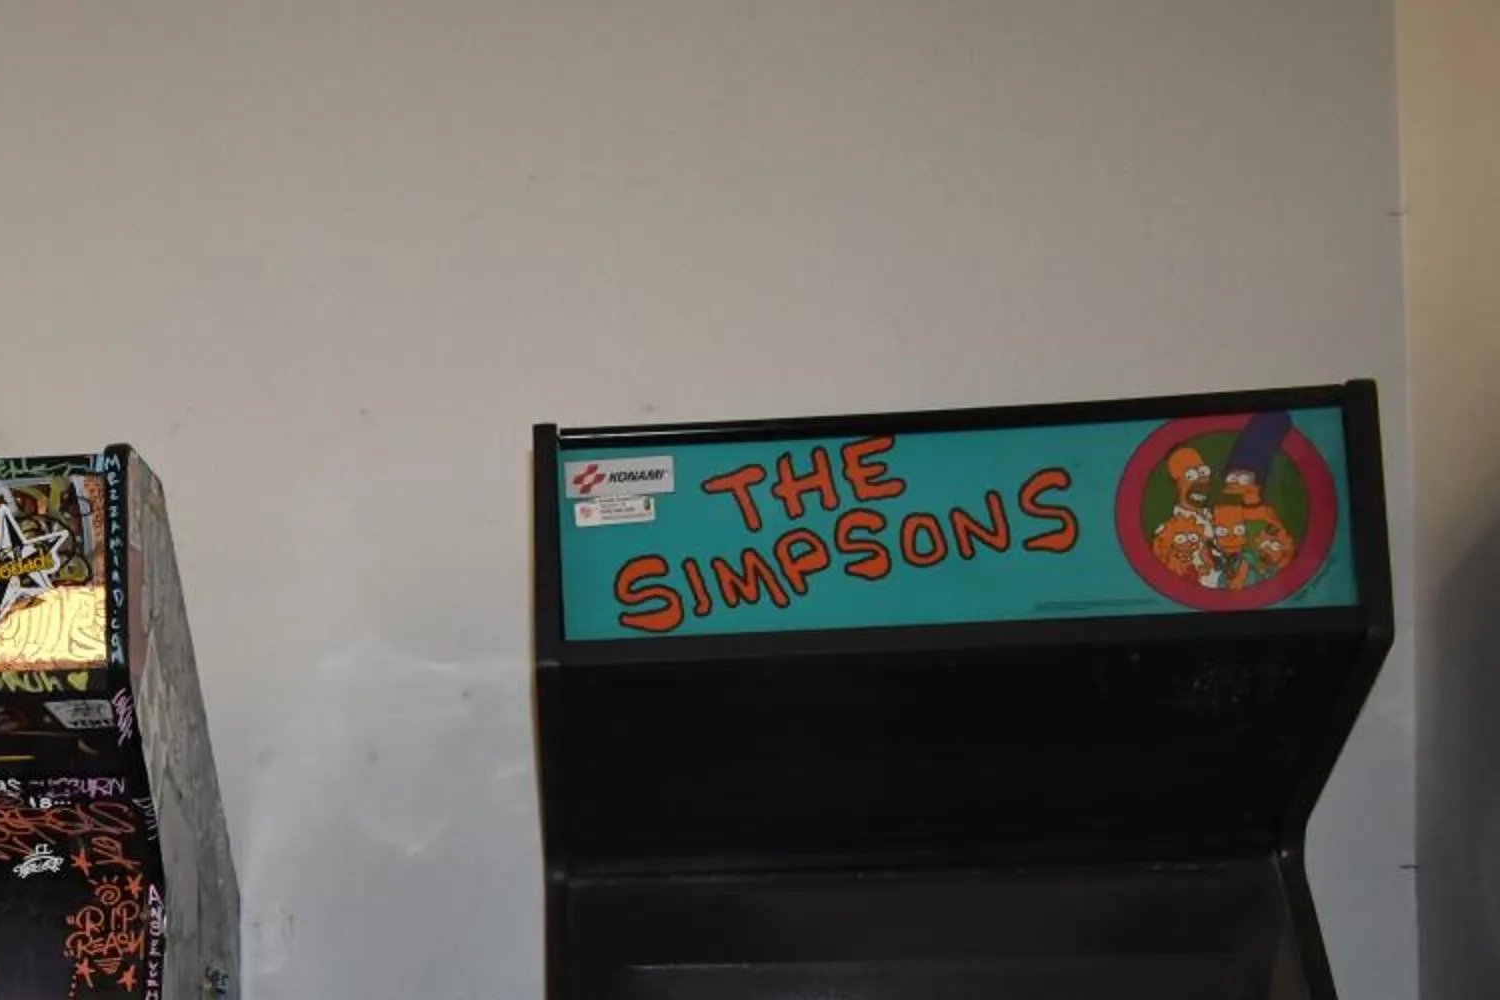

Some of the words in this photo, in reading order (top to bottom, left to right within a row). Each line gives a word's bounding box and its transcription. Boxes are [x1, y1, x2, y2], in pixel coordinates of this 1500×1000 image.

[608, 469, 665, 484] KONAMI
[700, 436, 907, 531] THE
[614, 468, 1080, 633] SIMPSONS
